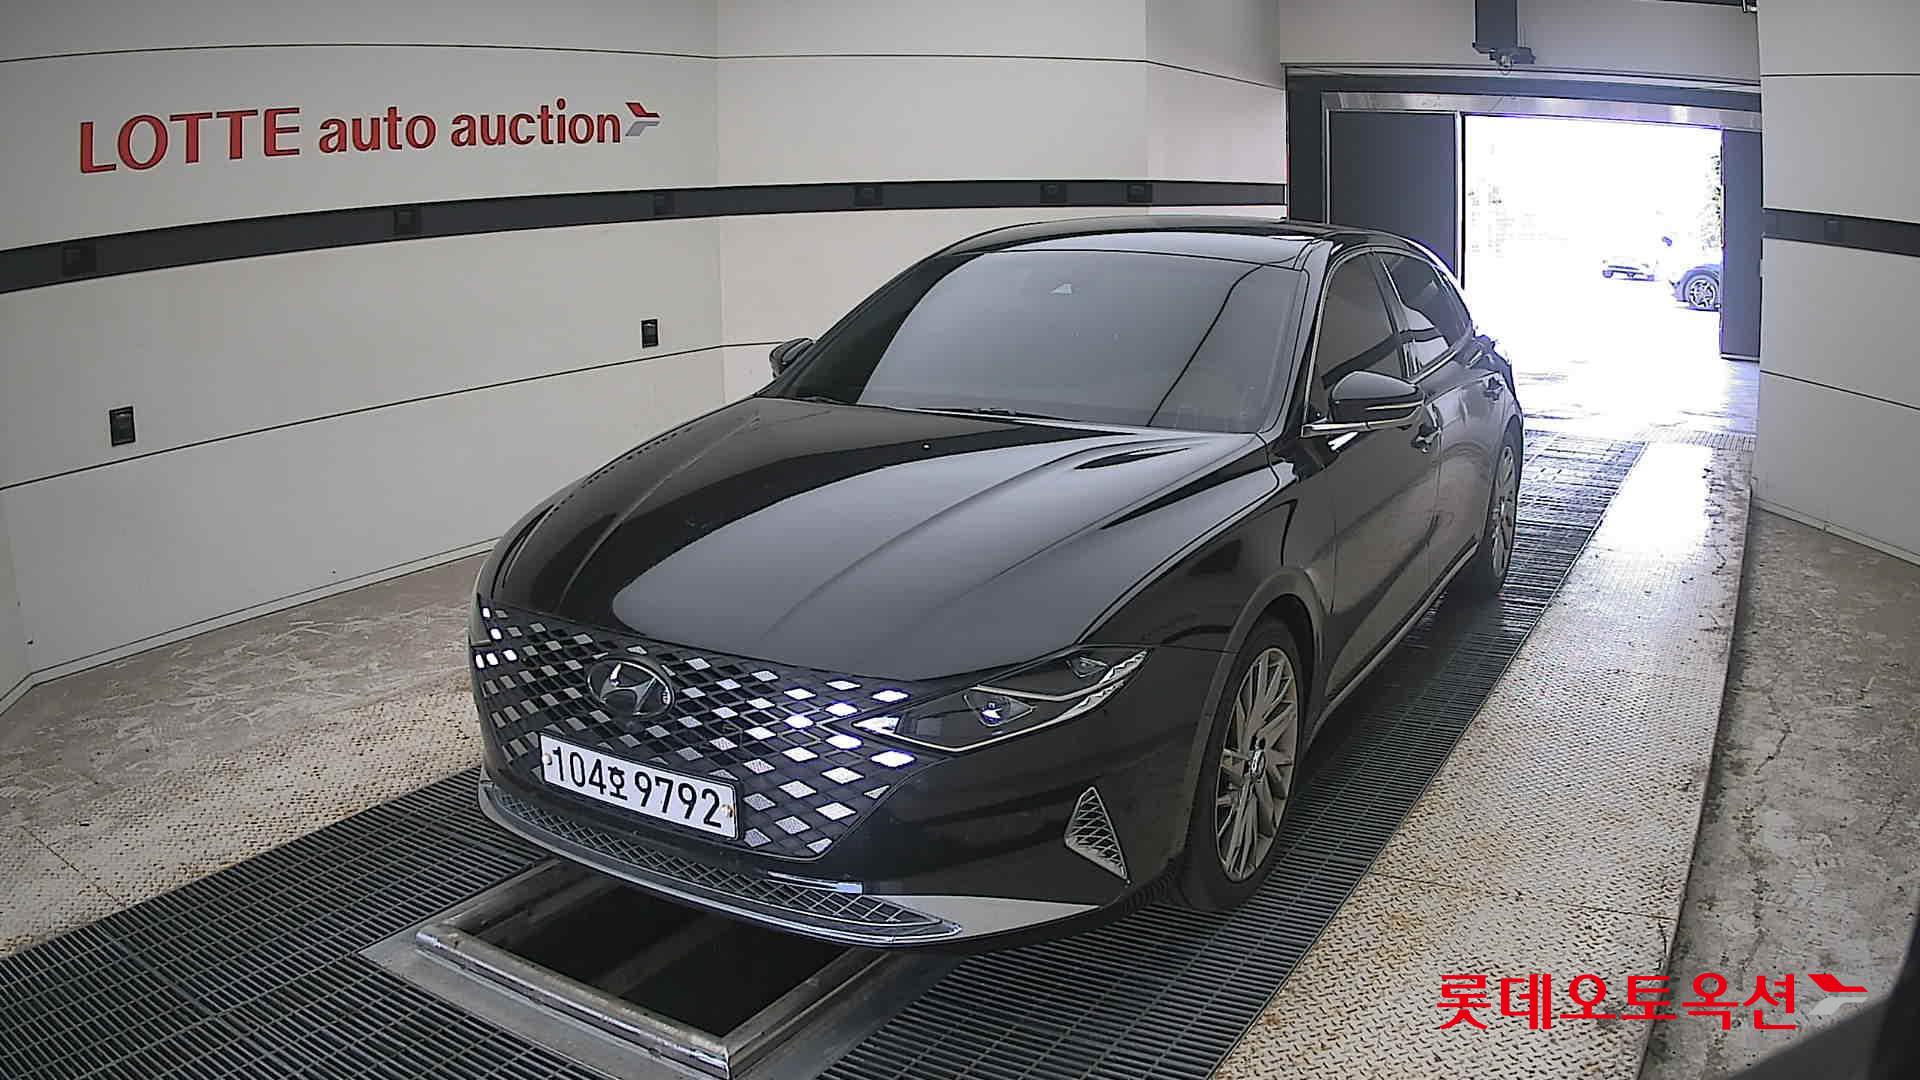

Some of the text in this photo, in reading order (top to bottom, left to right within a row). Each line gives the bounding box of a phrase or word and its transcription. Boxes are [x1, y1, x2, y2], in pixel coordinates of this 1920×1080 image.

[79, 97, 622, 174] LOTTE auto auction
